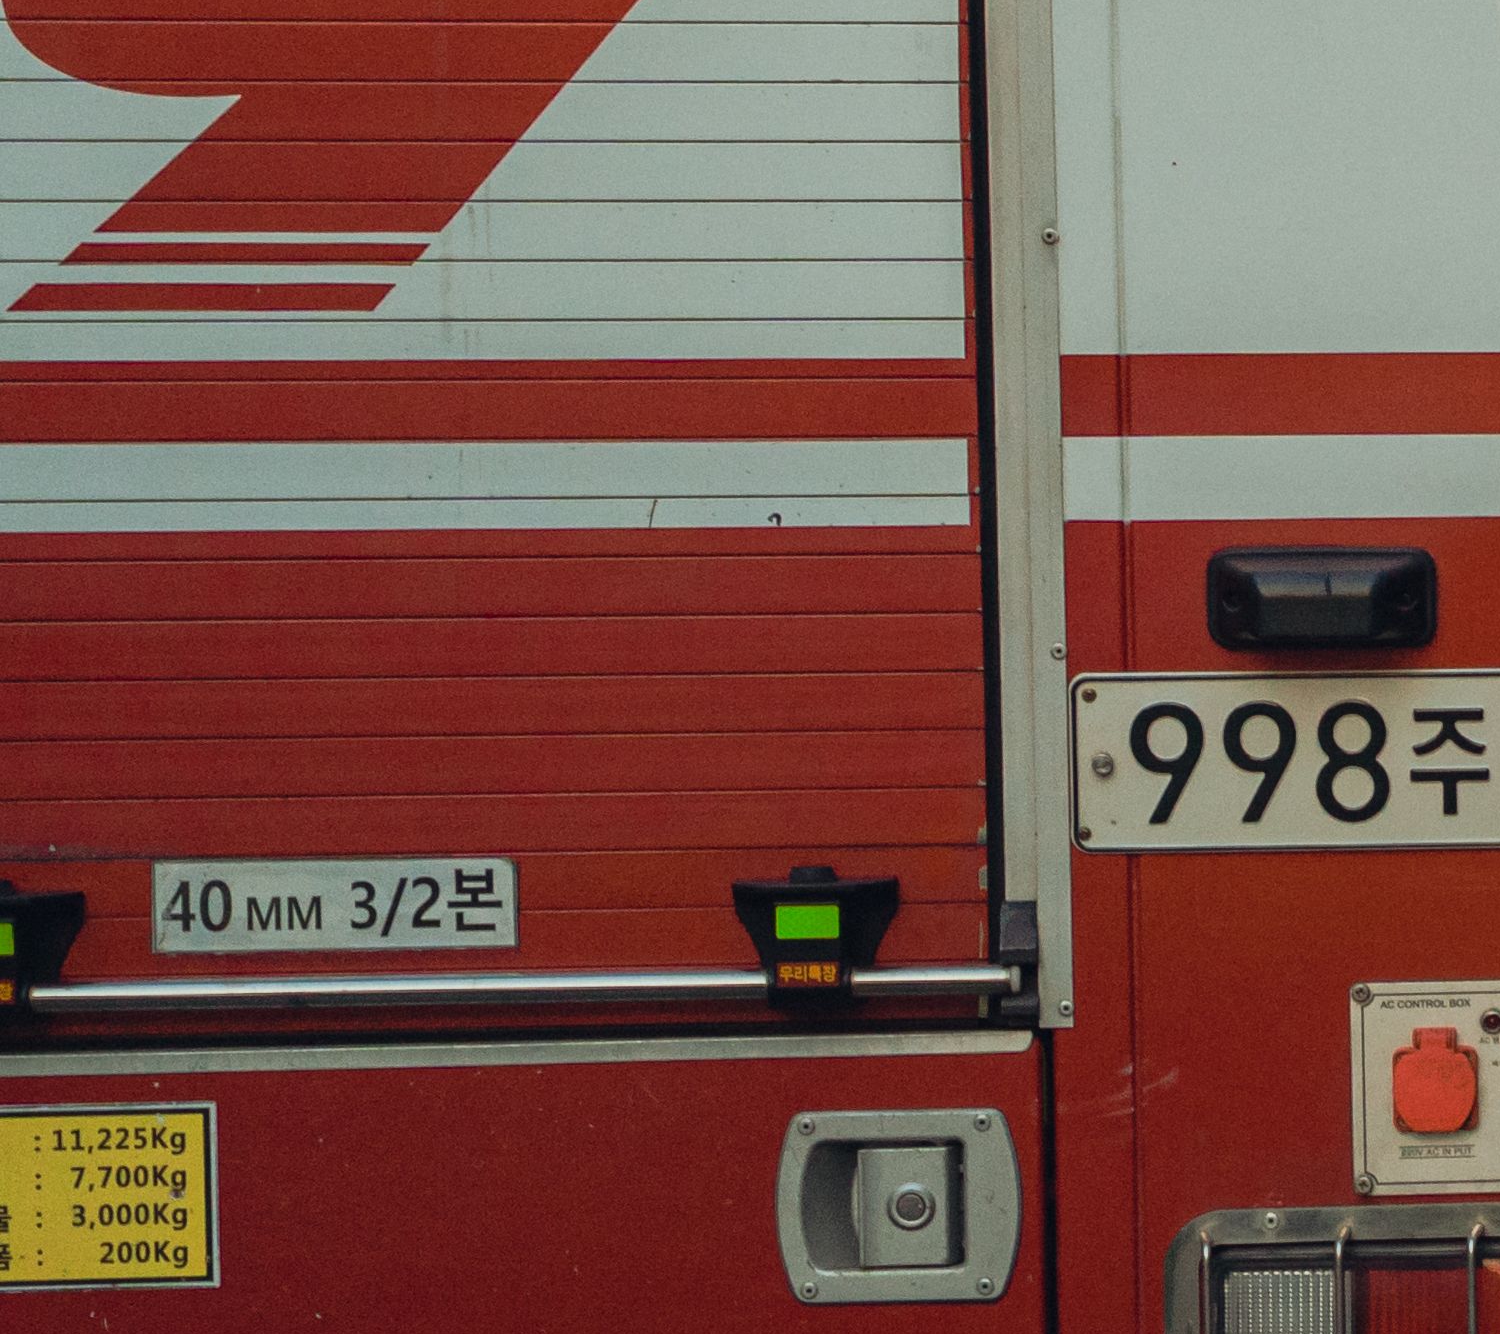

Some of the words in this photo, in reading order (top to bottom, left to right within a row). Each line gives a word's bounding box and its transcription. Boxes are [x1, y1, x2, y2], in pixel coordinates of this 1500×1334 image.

[1128, 700, 1491, 825] 998주
[161, 878, 233, 933] 40
[246, 895, 323, 932] MM
[348, 867, 503, 937] 3/2본
[1380, 1000, 1396, 1010] AC
[1398, 998, 1446, 1010] CONTROL
[1449, 998, 1472, 1008] BOX
[51, 1126, 187, 1155] 11,225Kg
[1426, 1147, 1441, 1157] AC
[1455, 1146, 1472, 1156] PUT
[70, 1165, 187, 1192] 7,700Kg
[71, 1203, 188, 1231] 3,000Kg
[100, 1240, 189, 1269] 200Kg
